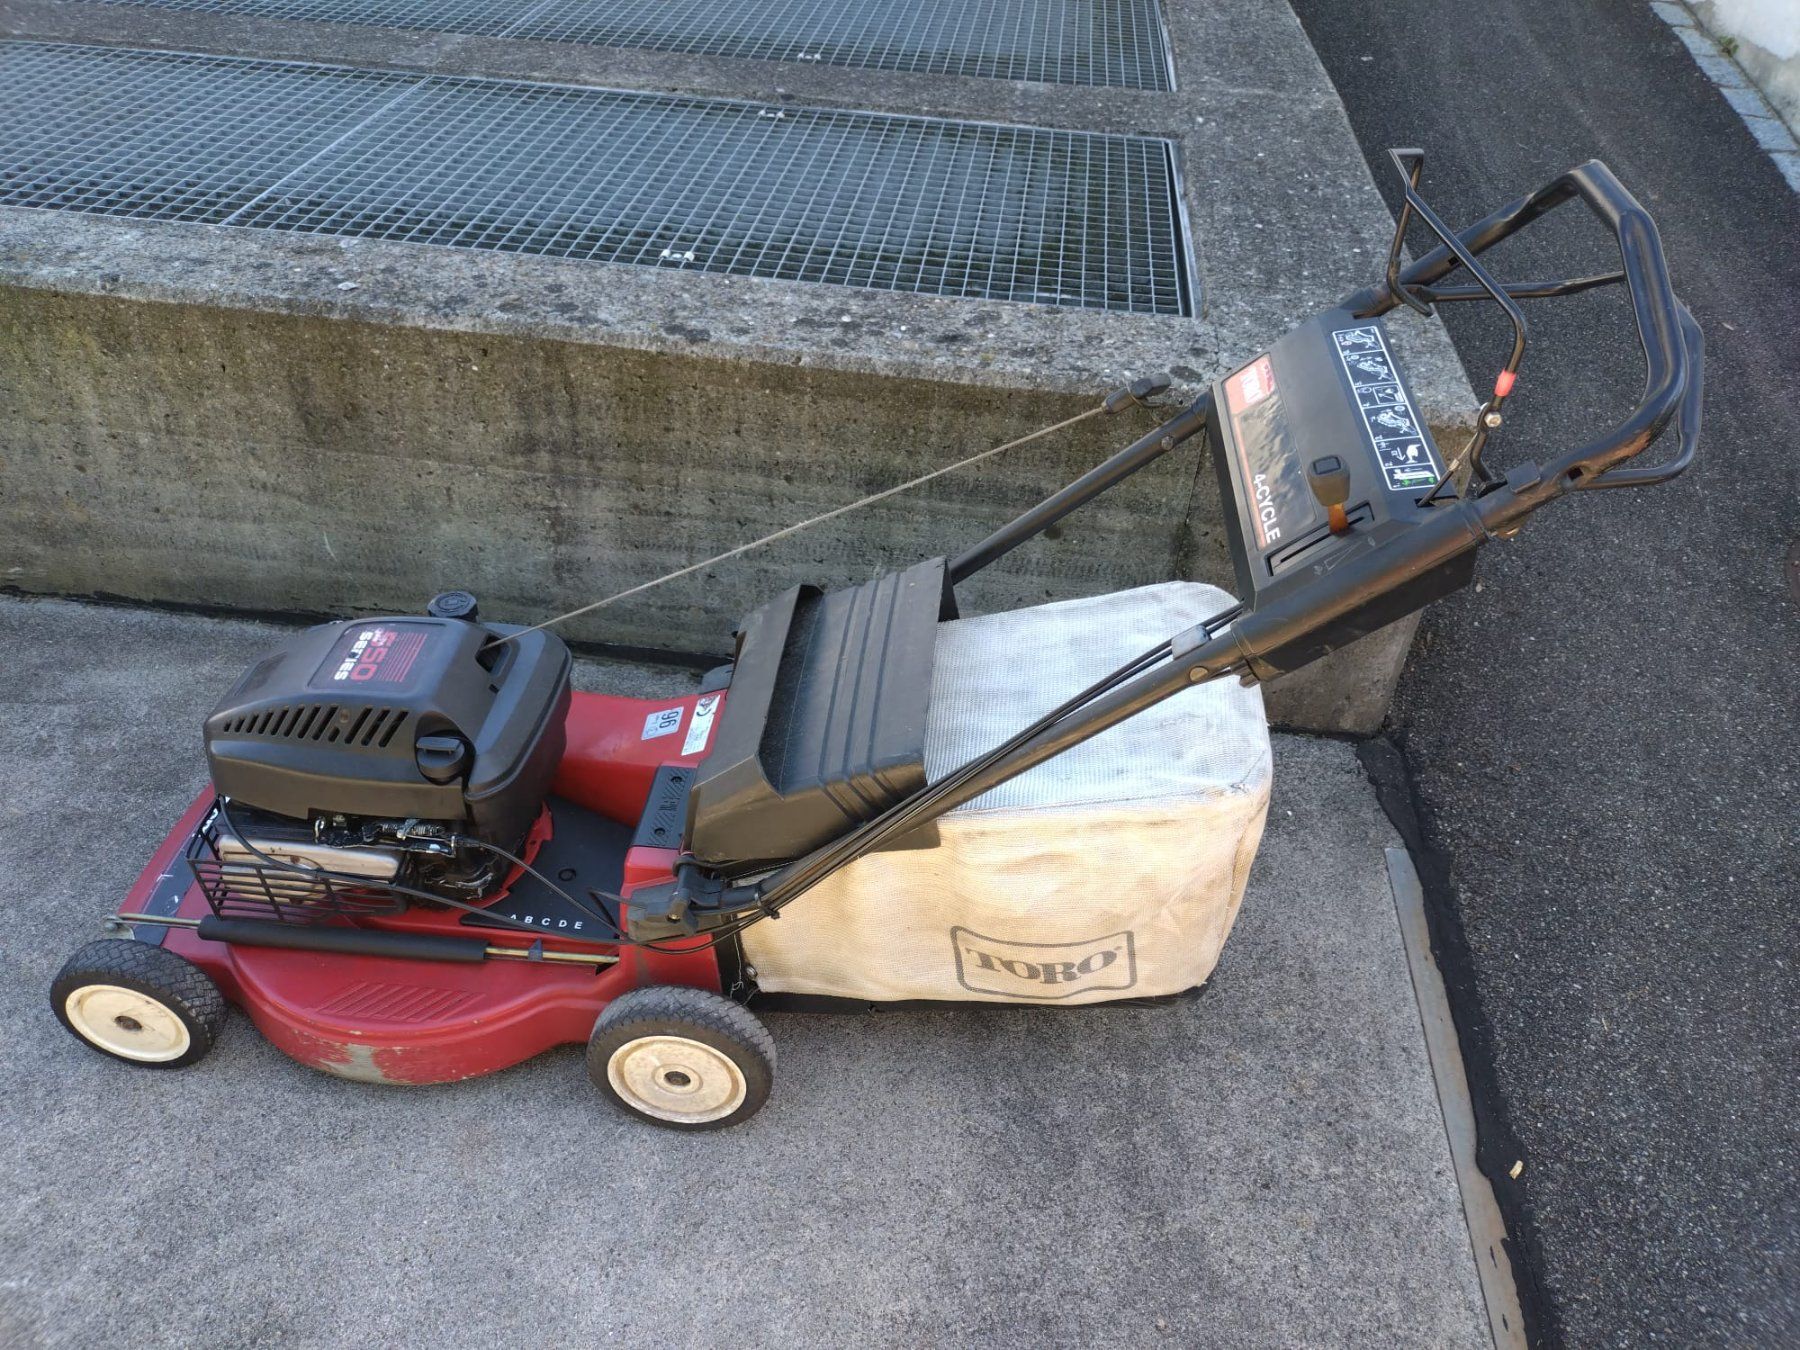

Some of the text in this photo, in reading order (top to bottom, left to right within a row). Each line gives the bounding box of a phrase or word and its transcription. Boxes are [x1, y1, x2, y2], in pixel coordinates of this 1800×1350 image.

[1253, 473, 1281, 544] 4-CYCLE
[659, 711, 679, 729] 96
[965, 947, 1122, 984] TORO
